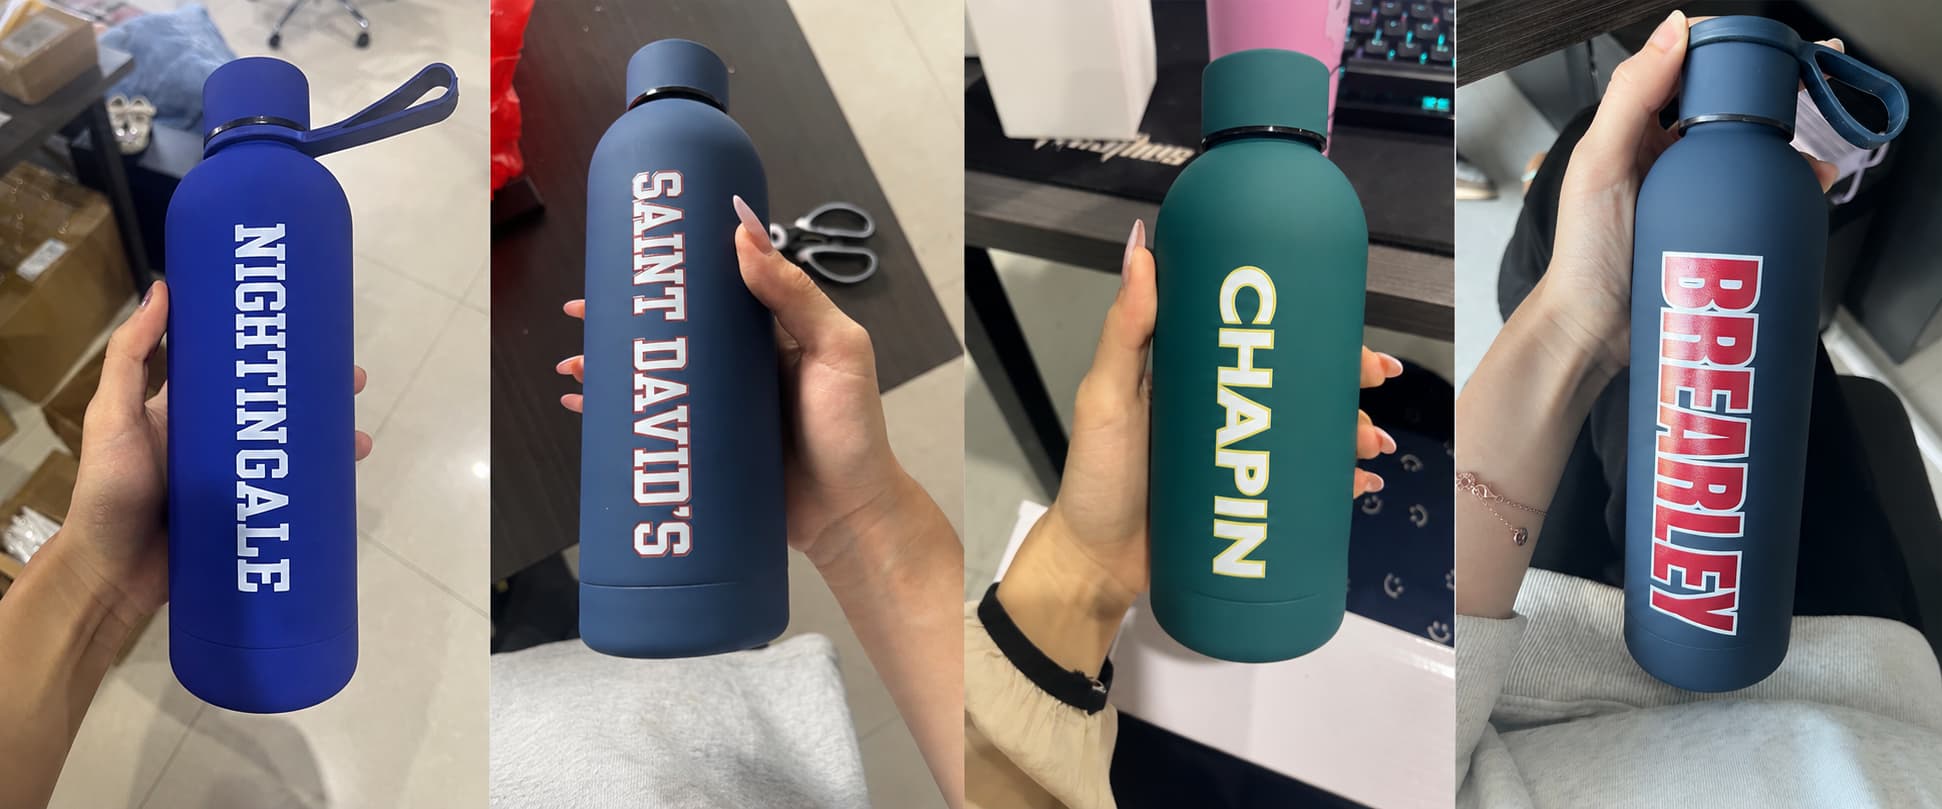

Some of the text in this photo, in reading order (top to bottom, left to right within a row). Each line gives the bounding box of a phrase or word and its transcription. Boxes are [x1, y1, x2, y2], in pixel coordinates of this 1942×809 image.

[234, 223, 290, 593] NIGHTINGALE
[632, 169, 693, 558] SAINT DAVID'S
[1212, 266, 1277, 578] CHAPIN
[1649, 251, 1763, 636] BREARLEY
